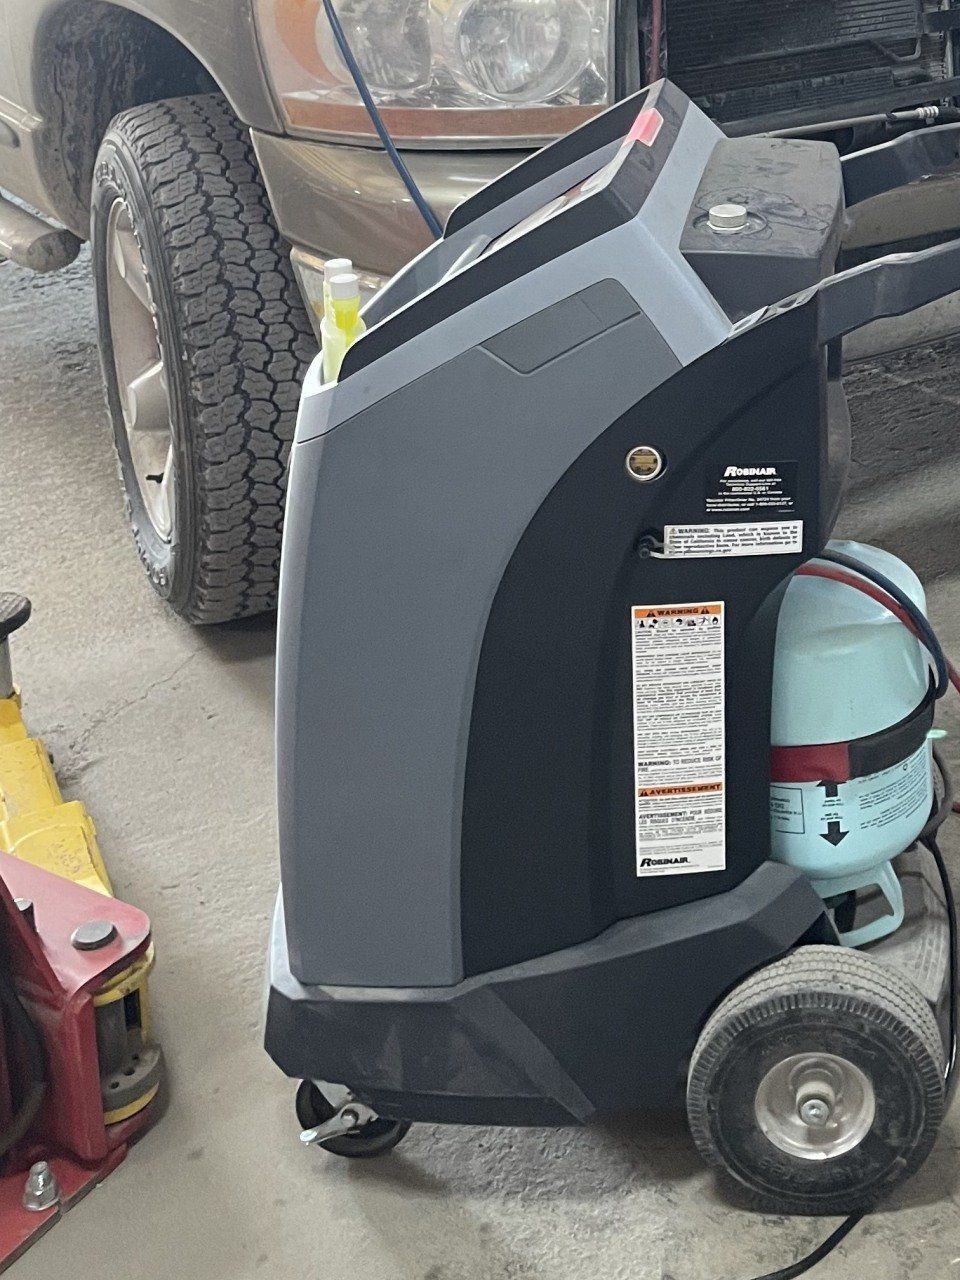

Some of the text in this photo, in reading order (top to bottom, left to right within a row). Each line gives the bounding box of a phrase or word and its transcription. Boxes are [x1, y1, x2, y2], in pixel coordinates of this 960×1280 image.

[724, 466, 777, 477] ROBINAIR
[657, 607, 699, 616] WARNING
[649, 783, 721, 795] AVERTISSEMENT
[640, 856, 689, 868] ROBINAIR
